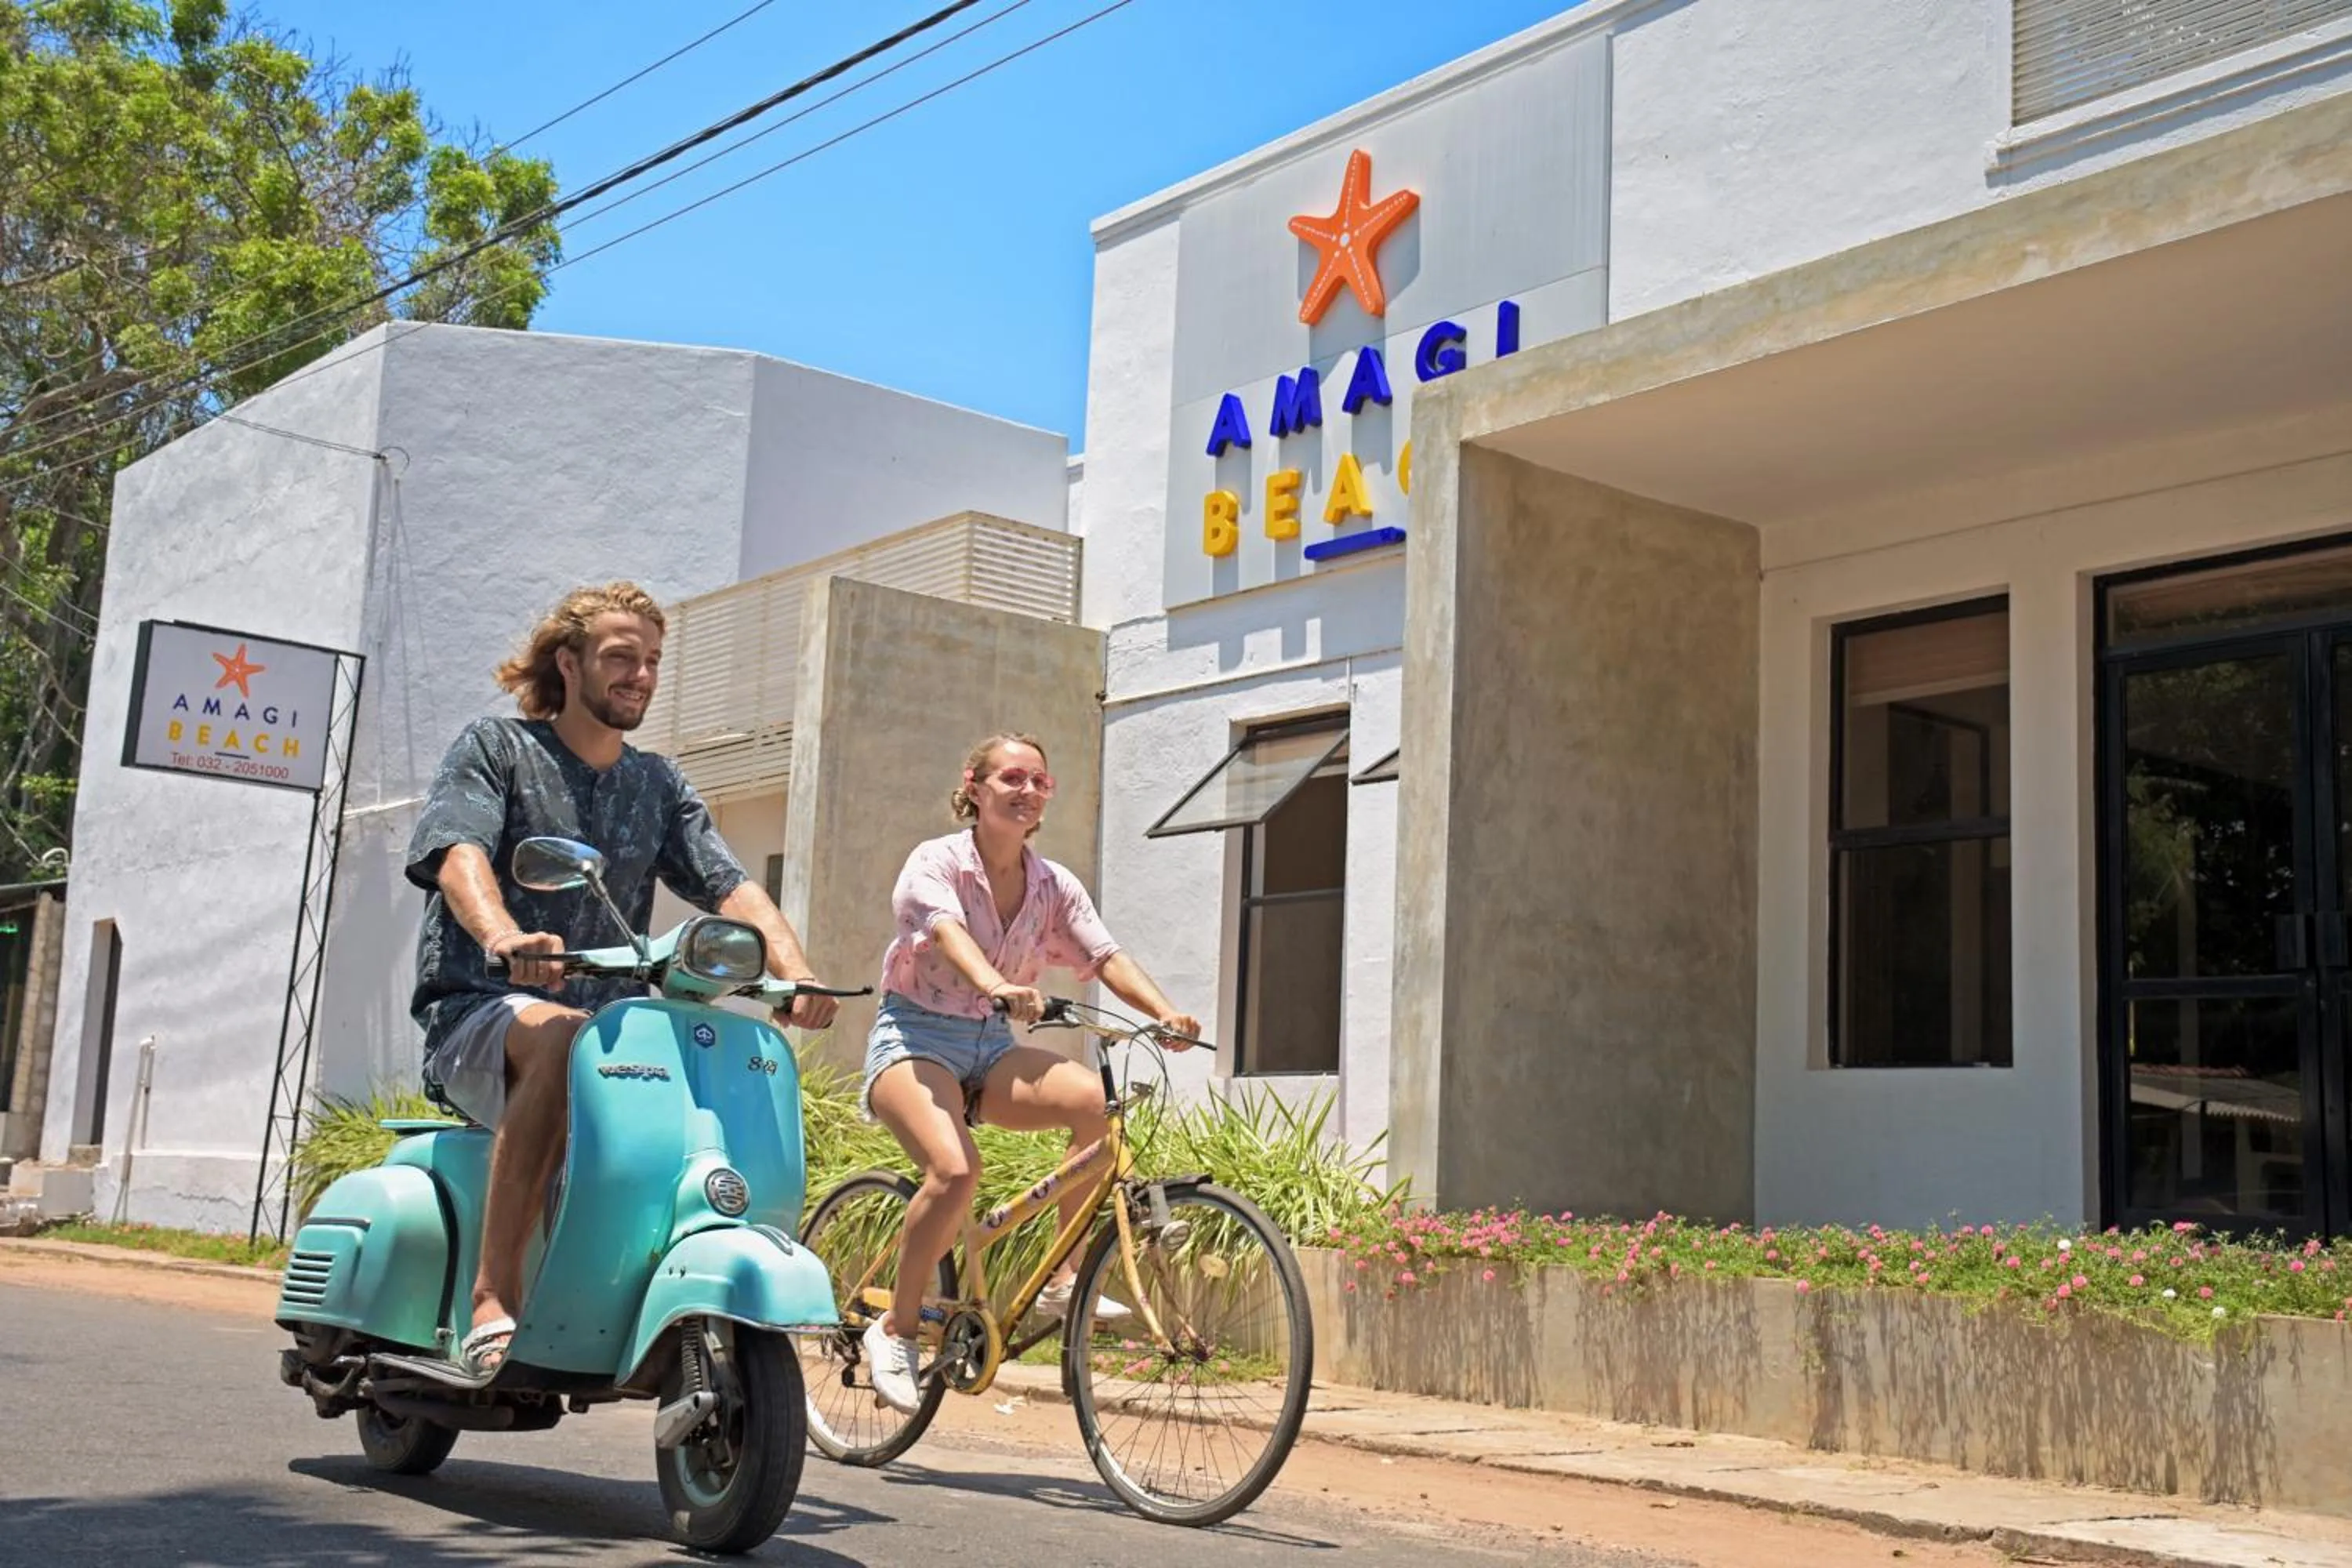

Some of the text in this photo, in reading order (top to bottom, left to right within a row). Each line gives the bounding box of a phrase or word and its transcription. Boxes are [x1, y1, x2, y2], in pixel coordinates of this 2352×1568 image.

[1207, 300, 1519, 457] AMAGI
[1203, 438, 1411, 557] BEA
[172, 693, 297, 728] AMAGI
[167, 720, 299, 758] BEACH
[197, 755, 221, 770] 032
[233, 760, 289, 779] 2051000
